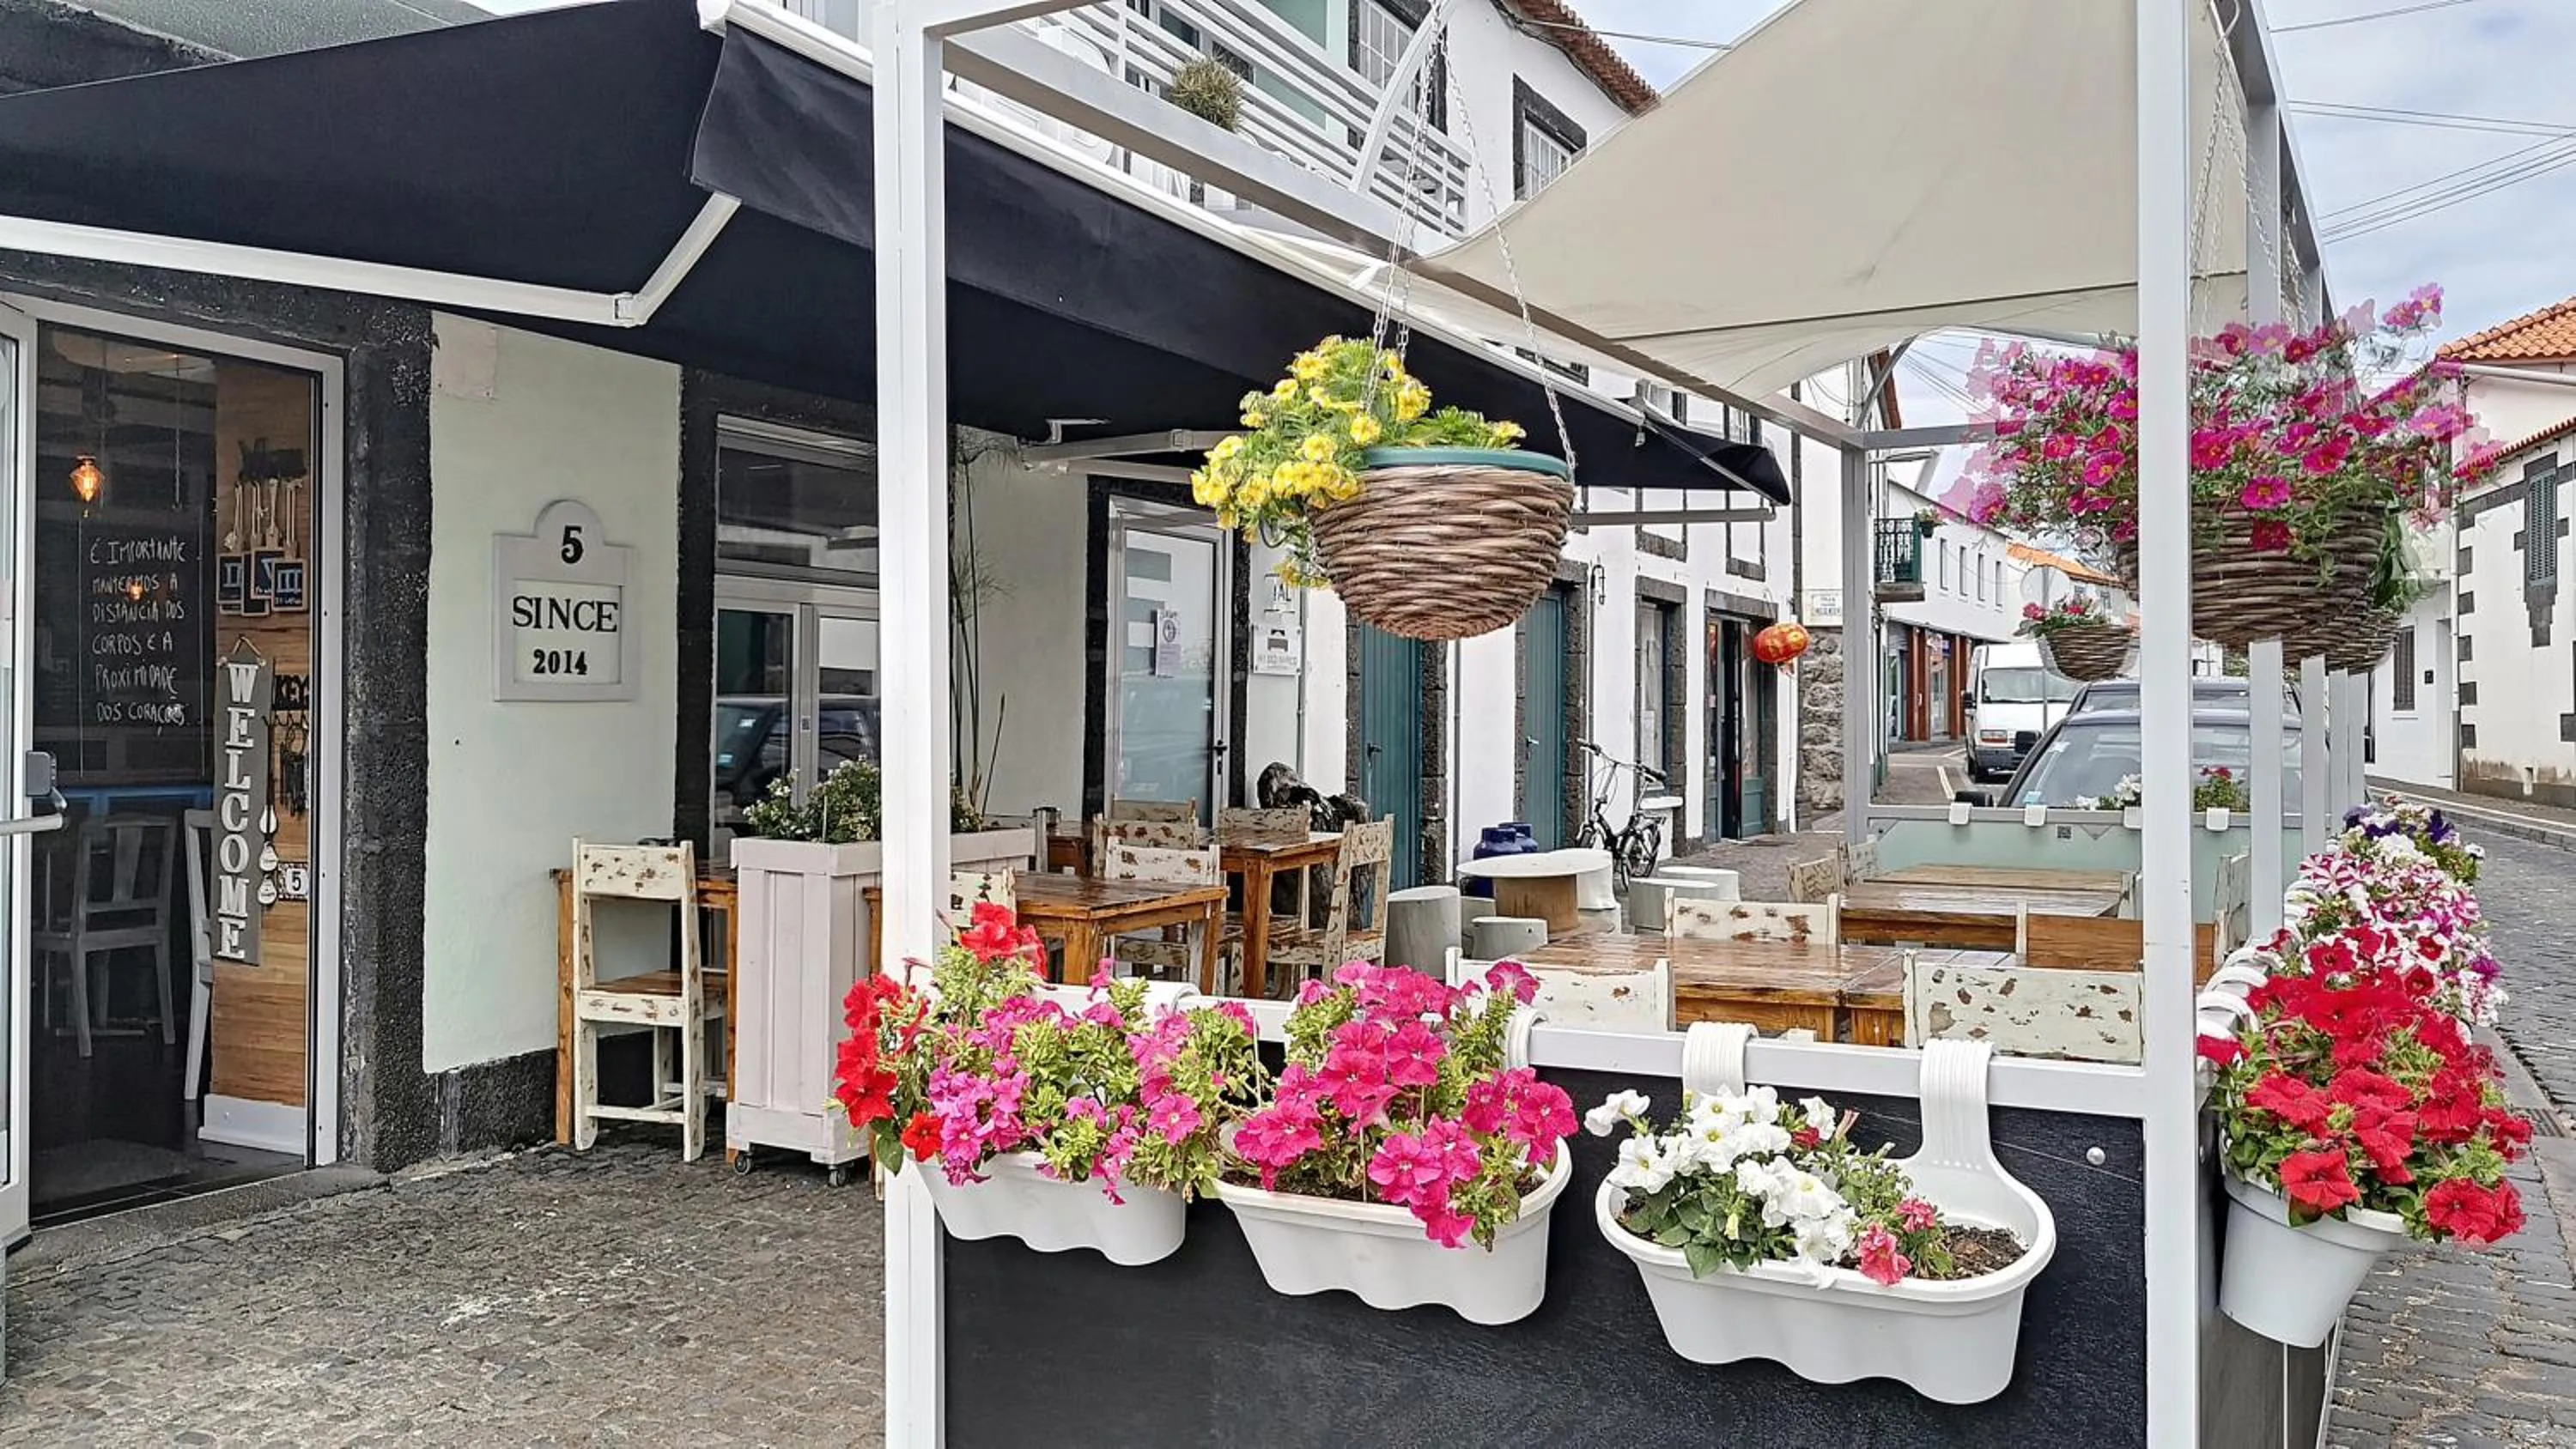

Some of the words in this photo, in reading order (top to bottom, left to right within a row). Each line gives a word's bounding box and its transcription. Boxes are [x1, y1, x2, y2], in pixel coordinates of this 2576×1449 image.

[561, 525, 584, 564] 5
[165, 600, 185, 619] DOS
[513, 595, 619, 633] SINCE
[92, 634, 142, 655] CORPOS
[162, 632, 173, 652] A
[532, 648, 587, 676] 2014
[97, 702, 122, 721] DOS
[217, 664, 258, 960] WELCOME
[292, 871, 301, 892] 5
